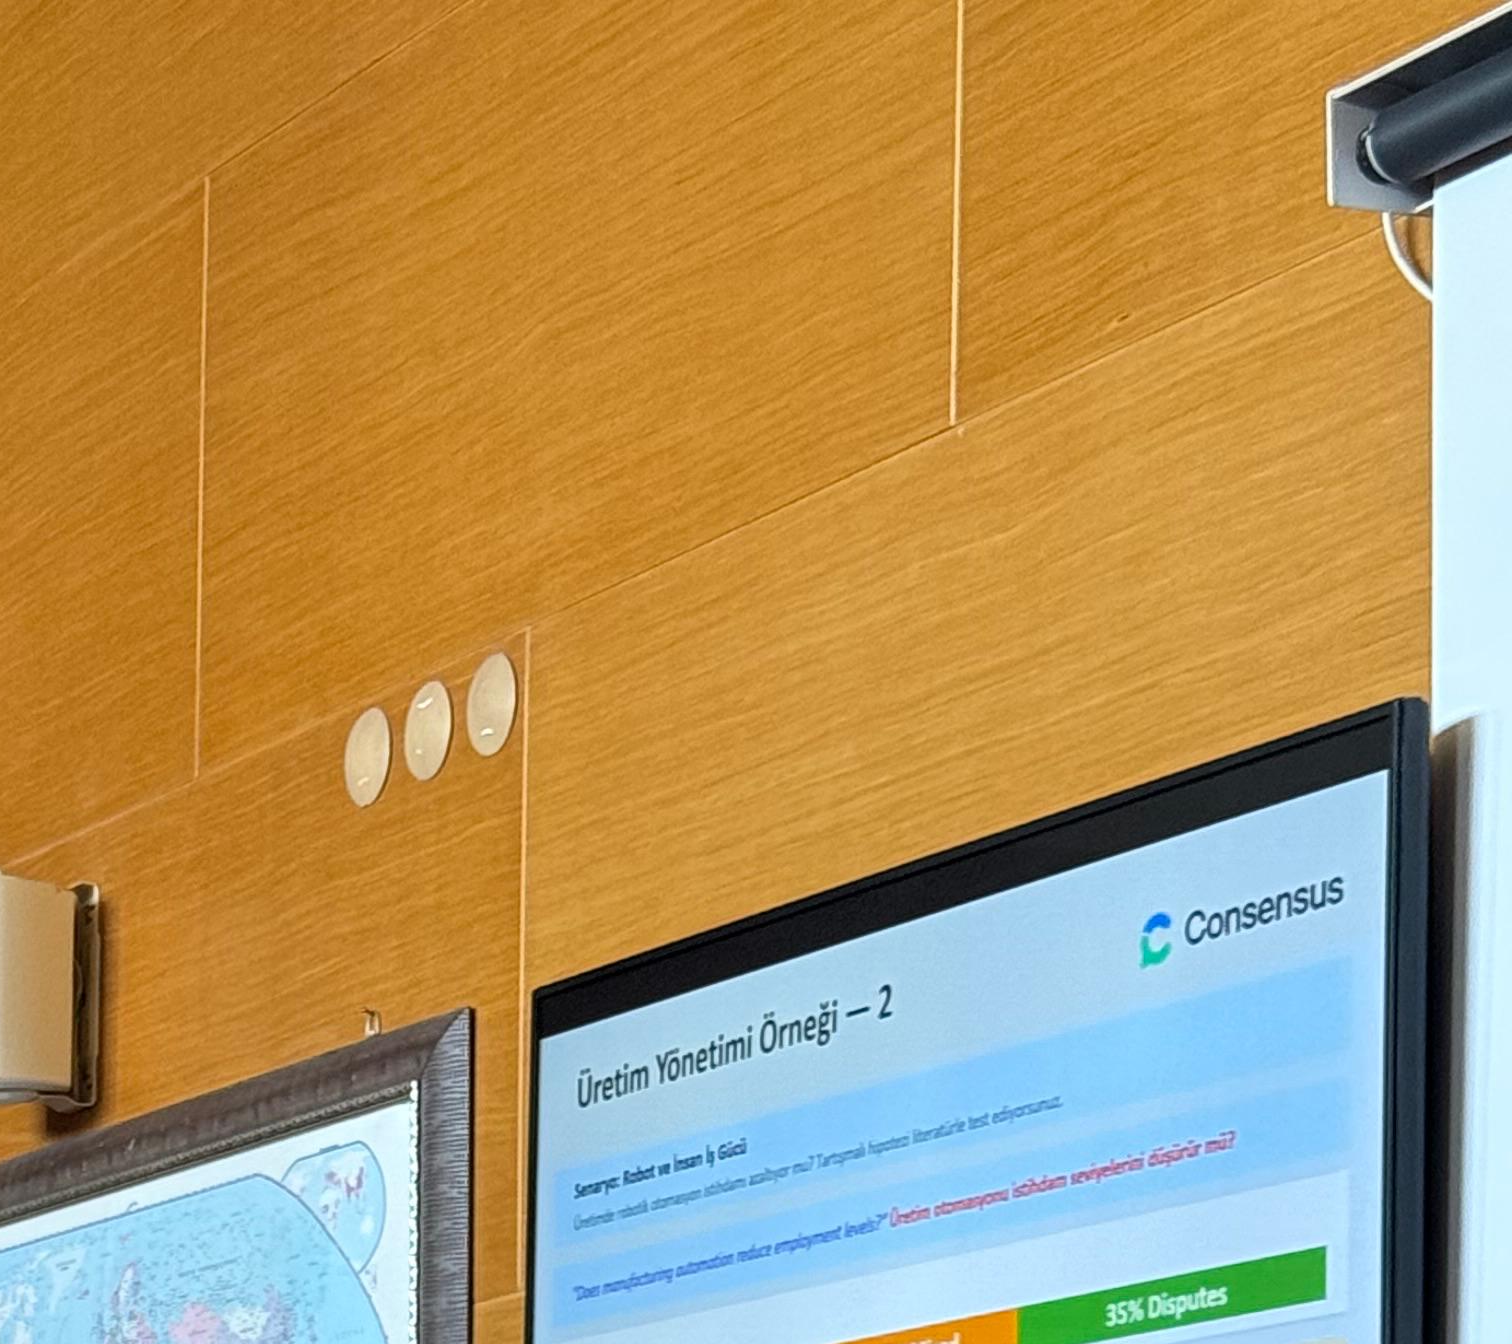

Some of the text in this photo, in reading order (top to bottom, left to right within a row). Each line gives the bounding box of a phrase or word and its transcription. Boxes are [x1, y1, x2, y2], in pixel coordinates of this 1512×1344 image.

[1185, 876, 1345, 946] Consensus
[577, 1063, 649, 1108] Üretim
[656, 1025, 753, 1085] Yönetimi
[760, 999, 838, 1054] Örneği
[878, 984, 893, 1020] 2
[968, 1112, 989, 1130] test
[623, 1165, 656, 1186] Robot
[658, 1162, 671, 1176] ve
[673, 1150, 703, 1173] İnsan
[706, 1144, 715, 1168] İş
[717, 1137, 748, 1161] Gücü
[737, 1244, 772, 1263] reduce
[774, 1225, 841, 1255] employment
[1105, 1286, 1228, 1328] 35% Disputes
